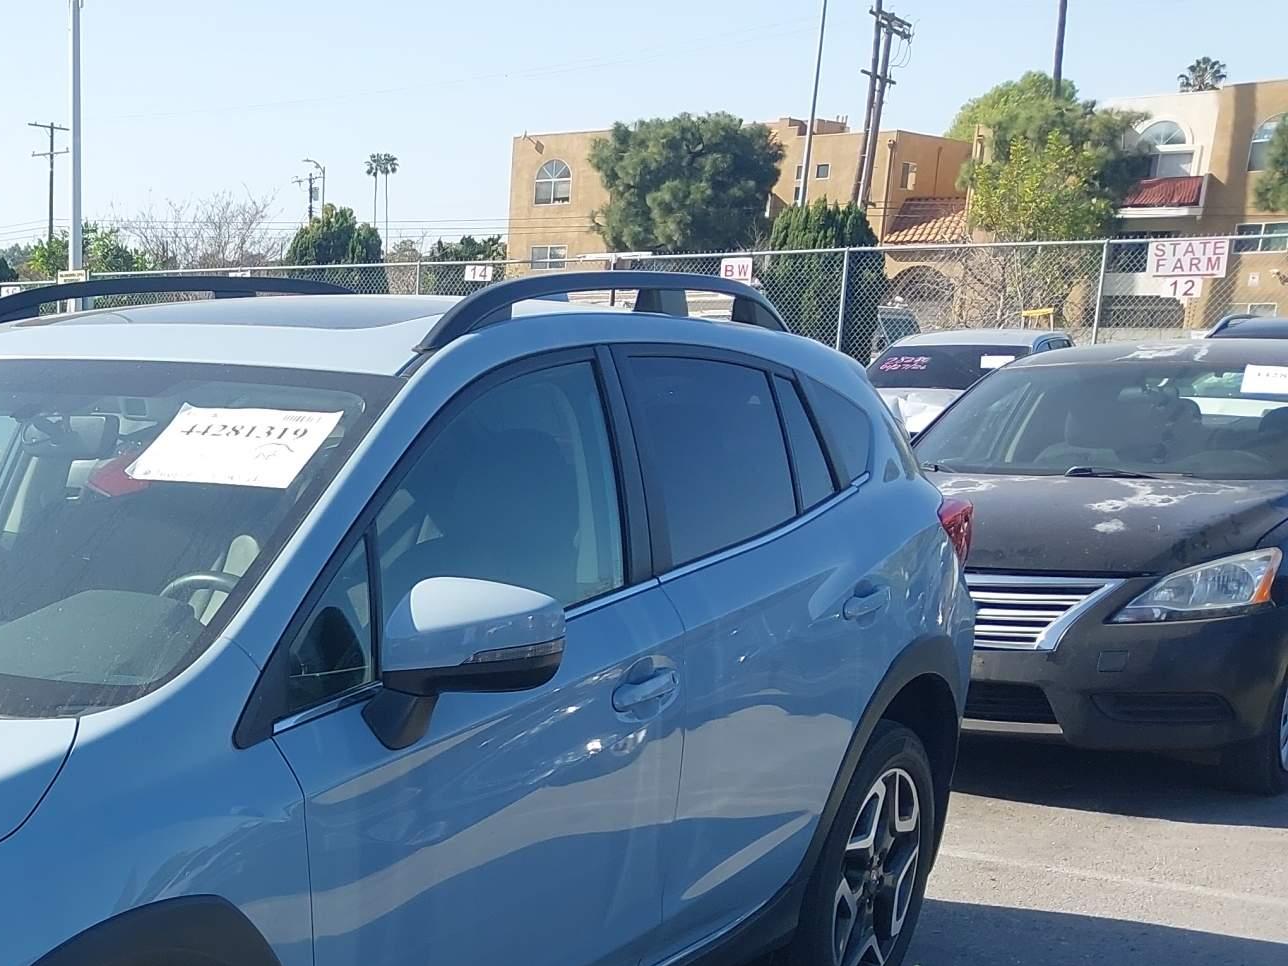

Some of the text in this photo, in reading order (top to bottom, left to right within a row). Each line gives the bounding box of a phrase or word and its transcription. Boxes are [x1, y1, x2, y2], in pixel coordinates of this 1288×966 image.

[1154, 240, 1226, 258] STATE
[470, 266, 488, 280] 14
[1155, 256, 1221, 273] FARM
[1169, 279, 1196, 297] 12
[180, 423, 309, 442] 44281319
